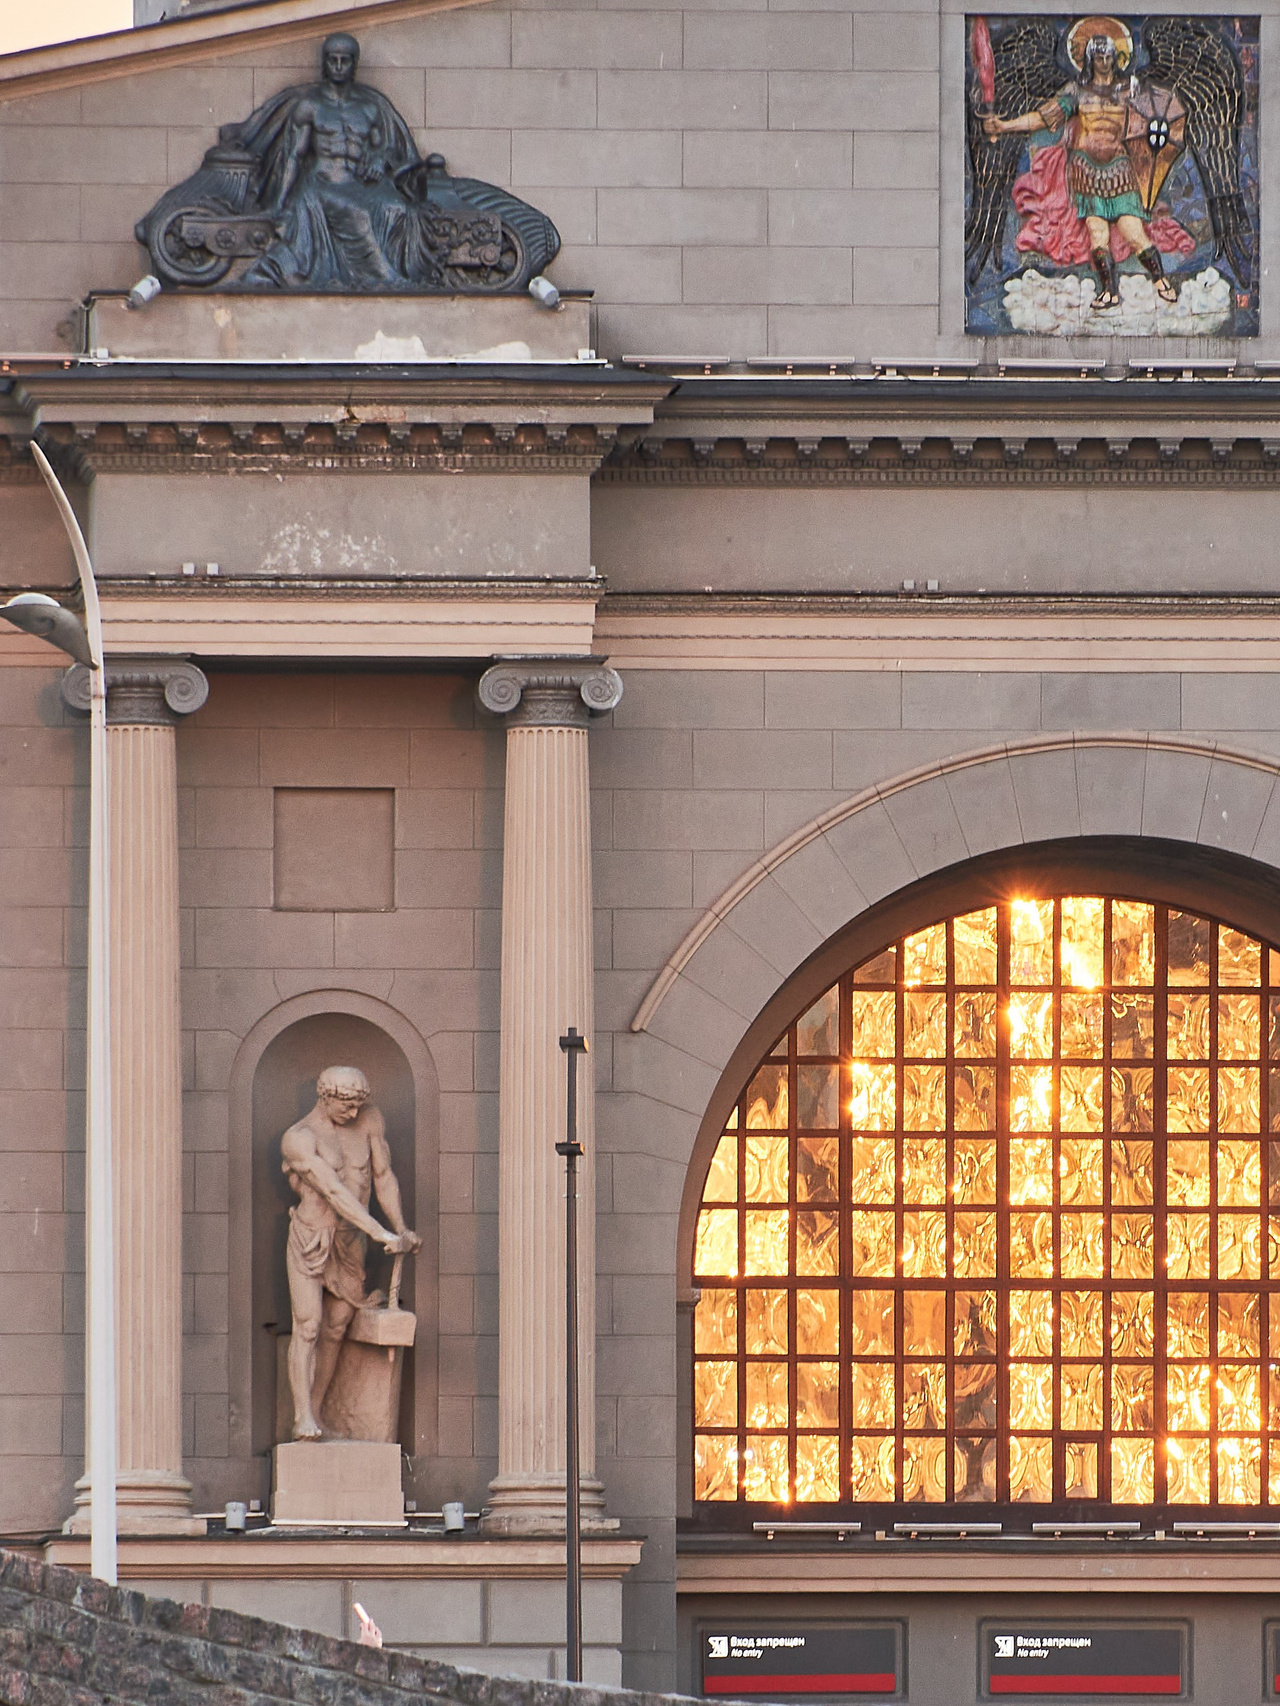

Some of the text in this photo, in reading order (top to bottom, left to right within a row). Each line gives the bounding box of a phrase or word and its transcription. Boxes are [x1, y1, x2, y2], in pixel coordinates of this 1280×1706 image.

[730, 1636, 805, 1649] Вход запрещен
[1016, 1636, 1092, 1649] Вход запрещен
[731, 1648, 763, 1659] No entry
[1017, 1648, 1049, 1659] No entry
